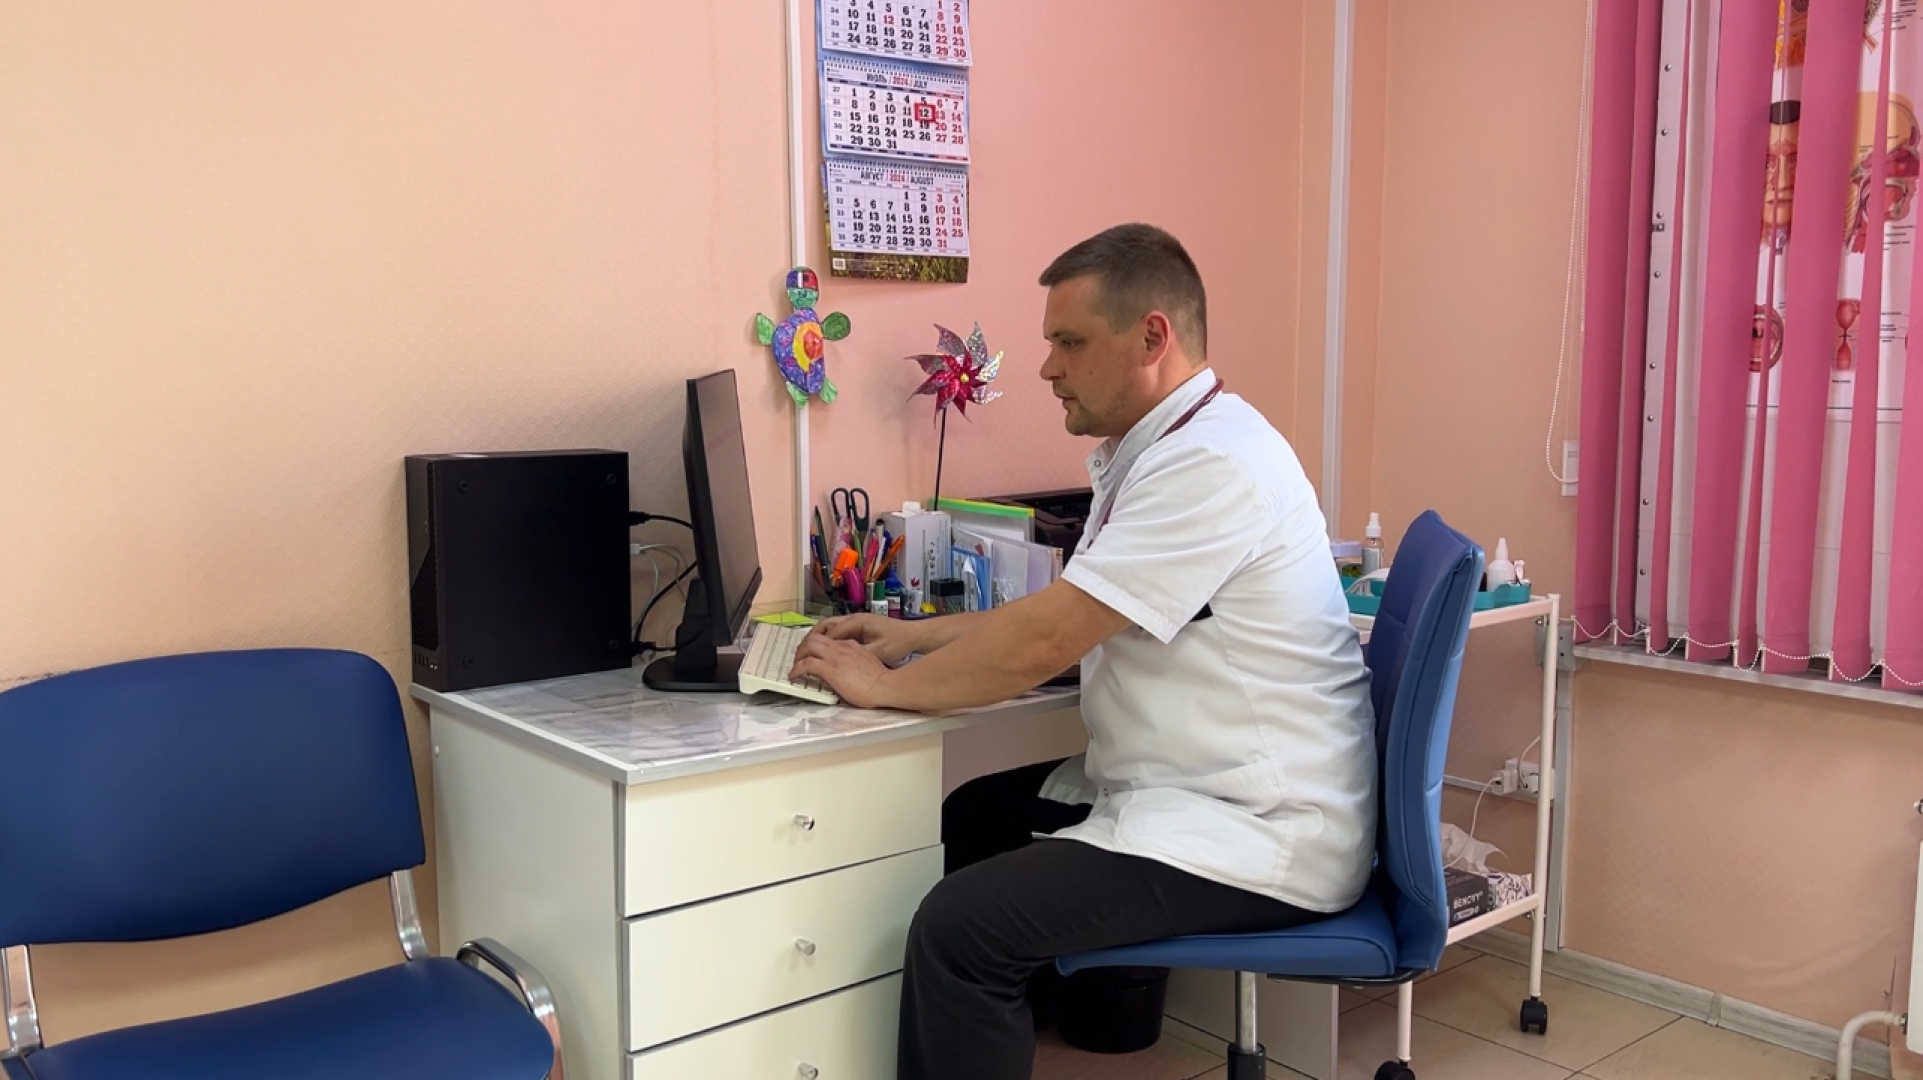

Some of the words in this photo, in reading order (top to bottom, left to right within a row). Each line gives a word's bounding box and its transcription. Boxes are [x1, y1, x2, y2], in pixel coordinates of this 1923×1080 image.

[867, 1, 874, 9] 4
[885, 3, 891, 12] 5
[903, 6, 909, 15] 6
[921, 9, 926, 18] 7
[938, 12, 943, 21] 8
[954, 14, 960, 23] 9
[938, 0, 942, 9] 1
[954, 3, 960, 11] 2
[848, 9, 858, 18] 10
[867, 12, 876, 21] 11
[884, 15, 894, 24] 12
[901, 18, 912, 27] 13
[918, 21, 929, 30] 14
[936, 24, 946, 32] 15
[953, 26, 963, 34] 16
[848, 22, 858, 30] 17
[866, 25, 876, 33] 18
[884, 27, 894, 36] 19
[901, 30, 913, 39] 20
[919, 32, 930, 41] 21
[936, 35, 948, 44] 22
[953, 38, 964, 46] 23
[848, 33, 860, 43] 24
[866, 36, 878, 45] 25
[884, 39, 896, 48] 26
[902, 42, 913, 51] 27
[919, 44, 931, 53] 28
[936, 46, 948, 55] 29
[954, 49, 966, 57] 30
[869, 90, 875, 99] 2
[887, 93, 893, 101] 3
[937, 99, 943, 108] 6
[852, 100, 858, 109] 8
[870, 102, 876, 111] 9
[885, 105, 896, 113] 10
[903, 107, 912, 116] 11
[919, 109, 929, 117] 12
[936, 111, 945, 120] 13
[952, 113, 961, 122] 14
[850, 112, 861, 121] 15
[868, 114, 878, 123] 16
[886, 117, 895, 125] 17
[903, 118, 912, 127] 18
[936, 123, 947, 131] 20
[952, 124, 962, 133] 21
[850, 124, 862, 133] 22
[867, 126, 880, 135] 23
[885, 128, 897, 137] 24
[903, 130, 915, 139] 25
[919, 132, 930, 141] 26
[936, 134, 947, 143] 27
[952, 135, 963, 144] 28
[851, 136, 863, 145] 29
[868, 138, 881, 147] 30
[887, 140, 897, 148] 31
[920, 193, 927, 201] 2
[854, 199, 860, 207] 5
[870, 200, 876, 209] 6
[904, 203, 909, 211] 8
[921, 204, 927, 213] 9
[935, 205, 945, 214] 10
[852, 210, 863, 219] 12
[870, 212, 879, 220] 13
[886, 214, 896, 222] 14
[903, 214, 912, 223] 15
[919, 216, 929, 224] 16
[952, 218, 962, 226] 18
[853, 222, 864, 231] 19
[869, 223, 881, 232] 20
[886, 224, 896, 233] 21
[902, 226, 914, 235] 22
[919, 227, 930, 236] 23
[936, 228, 947, 236] 24
[952, 229, 963, 237] 25
[853, 234, 865, 243] 26
[870, 235, 881, 244] 27
[886, 237, 897, 245] 28
[903, 238, 915, 246] 29
[919, 238, 932, 247] 30
[937, 239, 947, 248] 31
